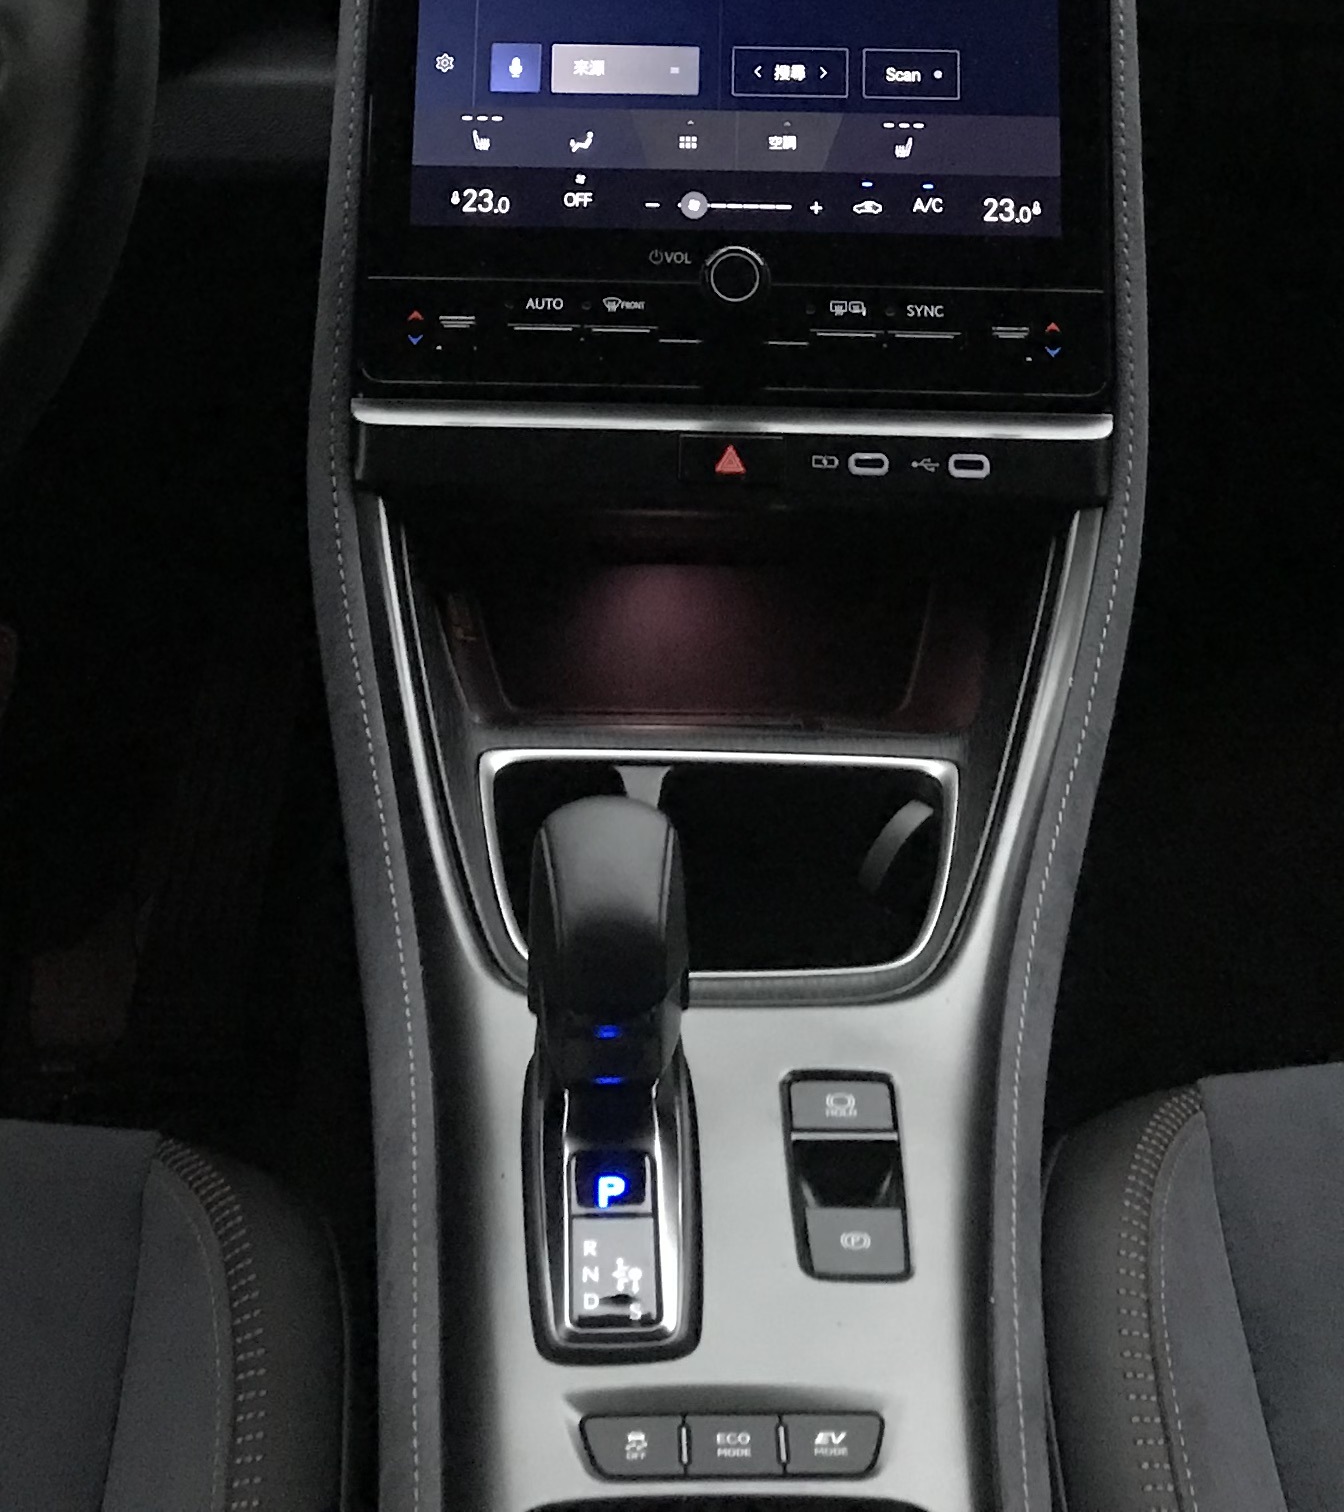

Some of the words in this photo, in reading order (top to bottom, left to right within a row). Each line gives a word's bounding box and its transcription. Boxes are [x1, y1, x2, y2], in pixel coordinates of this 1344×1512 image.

[885, 66, 922, 83] Scan
[462, 188, 510, 215] 23.0
[563, 191, 593, 208] OFF
[912, 197, 944, 214] A/C
[983, 197, 1033, 224] 23.0
[665, 251, 692, 264] VOL
[525, 297, 564, 310] AUTO
[906, 304, 944, 317] SYNC
[597, 1175, 626, 1209] P
[583, 1239, 598, 1257] R
[582, 1266, 599, 1283] N
[583, 1292, 600, 1310] D
[629, 1302, 642, 1320] S
[716, 1432, 751, 1445] ECO
[814, 1431, 847, 1445] EV
[716, 1447, 752, 1458] MODE
[813, 1446, 849, 1457] MODE
